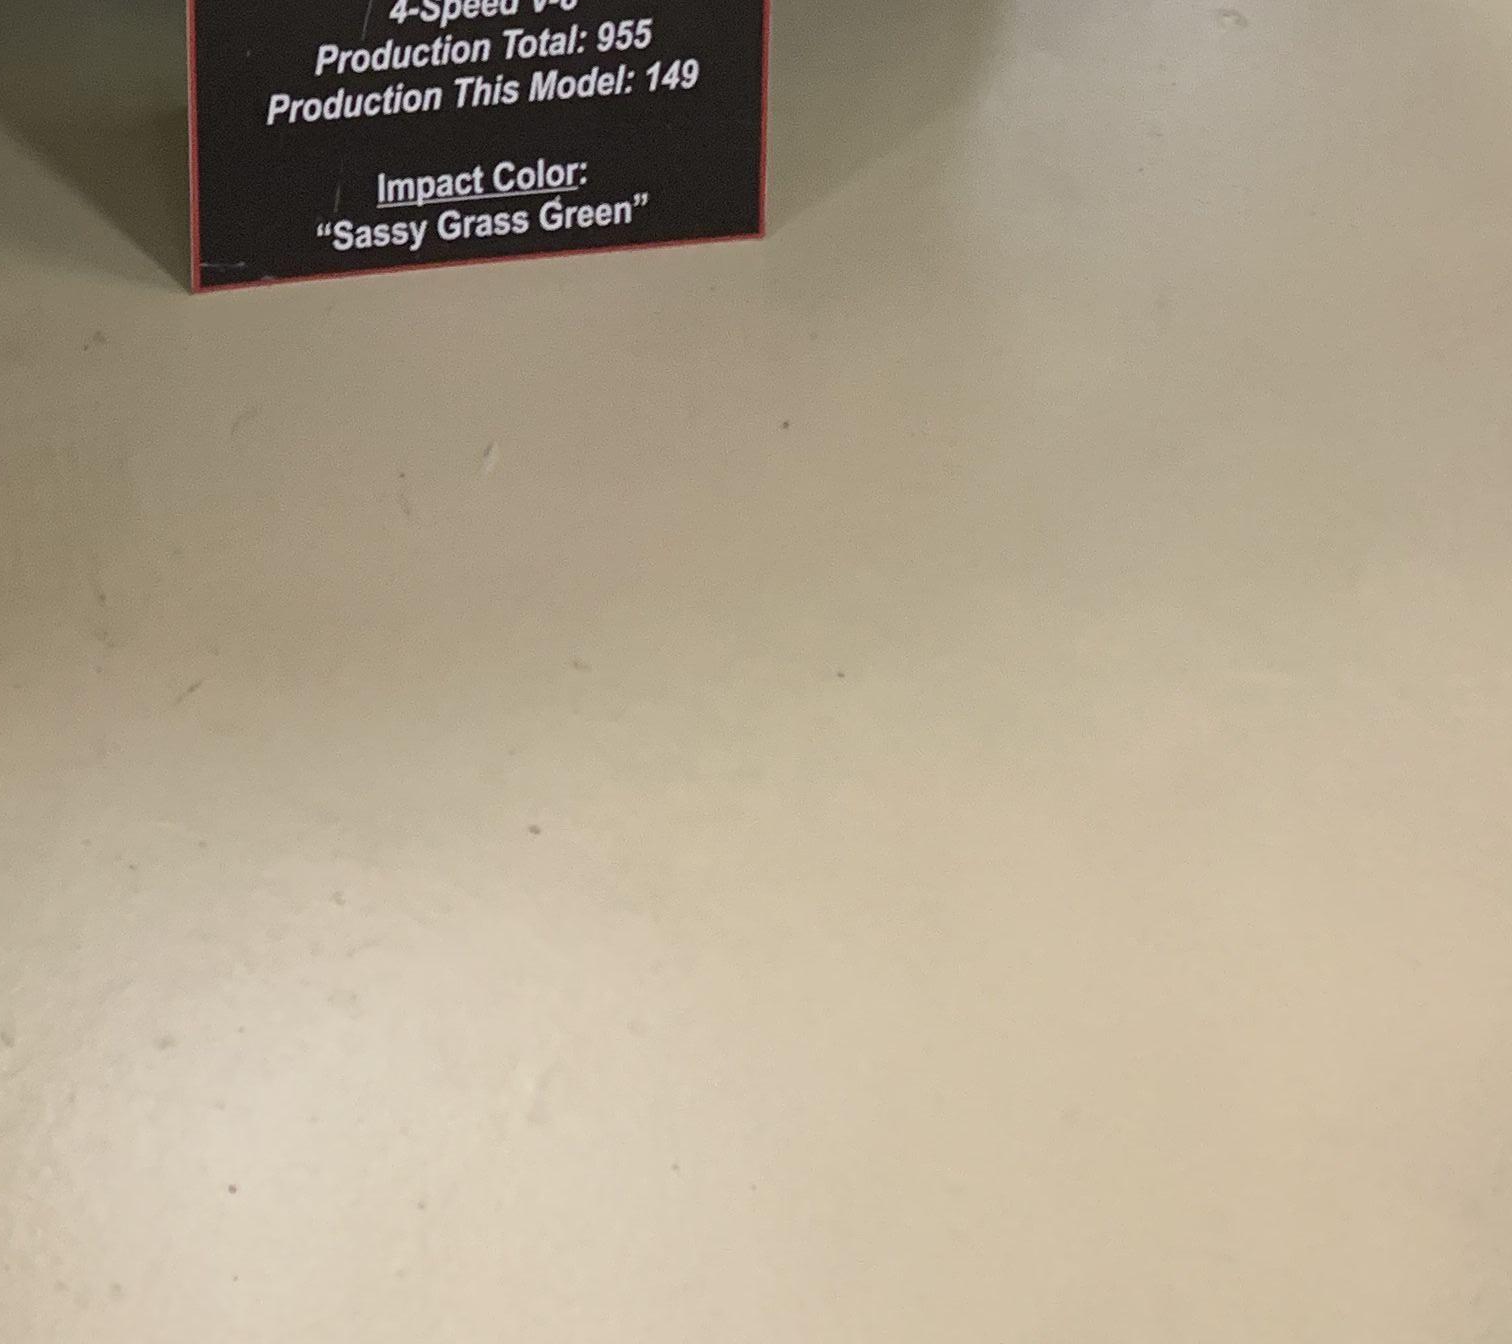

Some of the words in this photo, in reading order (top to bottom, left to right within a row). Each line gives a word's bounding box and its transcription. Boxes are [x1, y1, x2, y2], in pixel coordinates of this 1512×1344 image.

[314, 32, 492, 78] Production
[503, 26, 587, 61] Total:
[596, 19, 653, 53] 955
[265, 82, 444, 127] Production
[454, 74, 521, 108] This
[528, 65, 635, 101] Model:
[646, 57, 700, 93] 149
[376, 164, 485, 210] Impact
[492, 158, 589, 196] Color:
[316, 219, 428, 253] “Sassy
[437, 208, 532, 242] Grass
[538, 193, 649, 233] Green”
